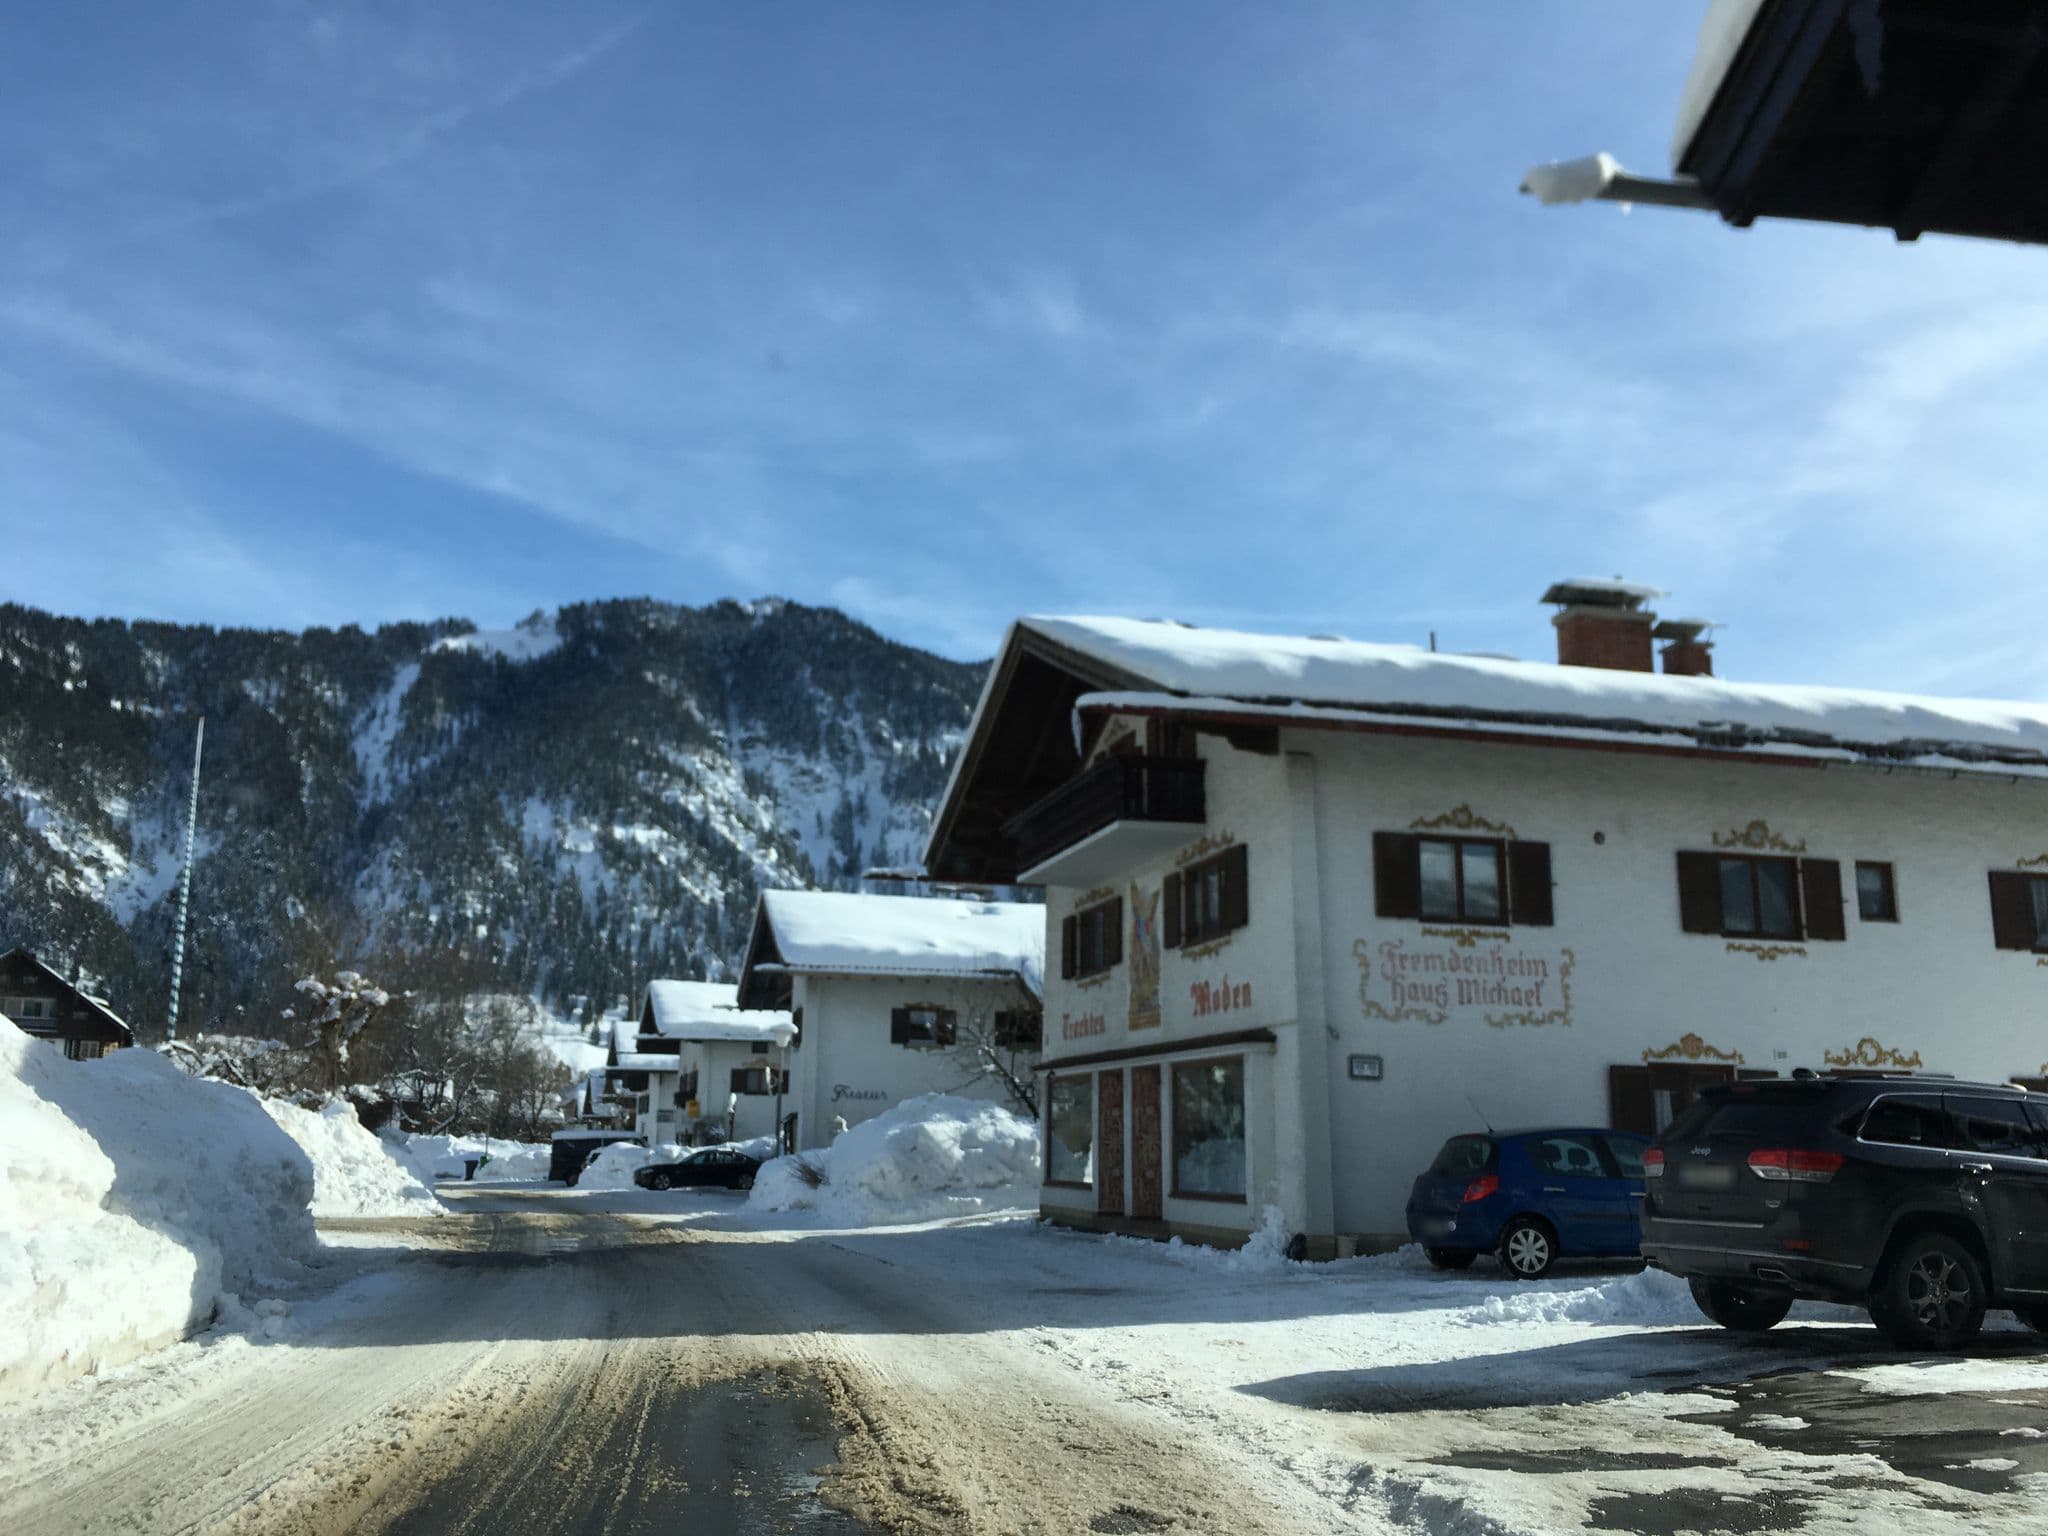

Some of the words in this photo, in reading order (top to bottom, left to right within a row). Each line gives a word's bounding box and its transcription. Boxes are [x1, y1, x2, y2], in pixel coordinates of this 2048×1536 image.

[1378, 937, 1549, 981] Fremdenheim
[1190, 974, 1252, 1017] Moden
[1457, 977, 1544, 1007] Michael
[1690, 1145, 1711, 1157] Jeep
